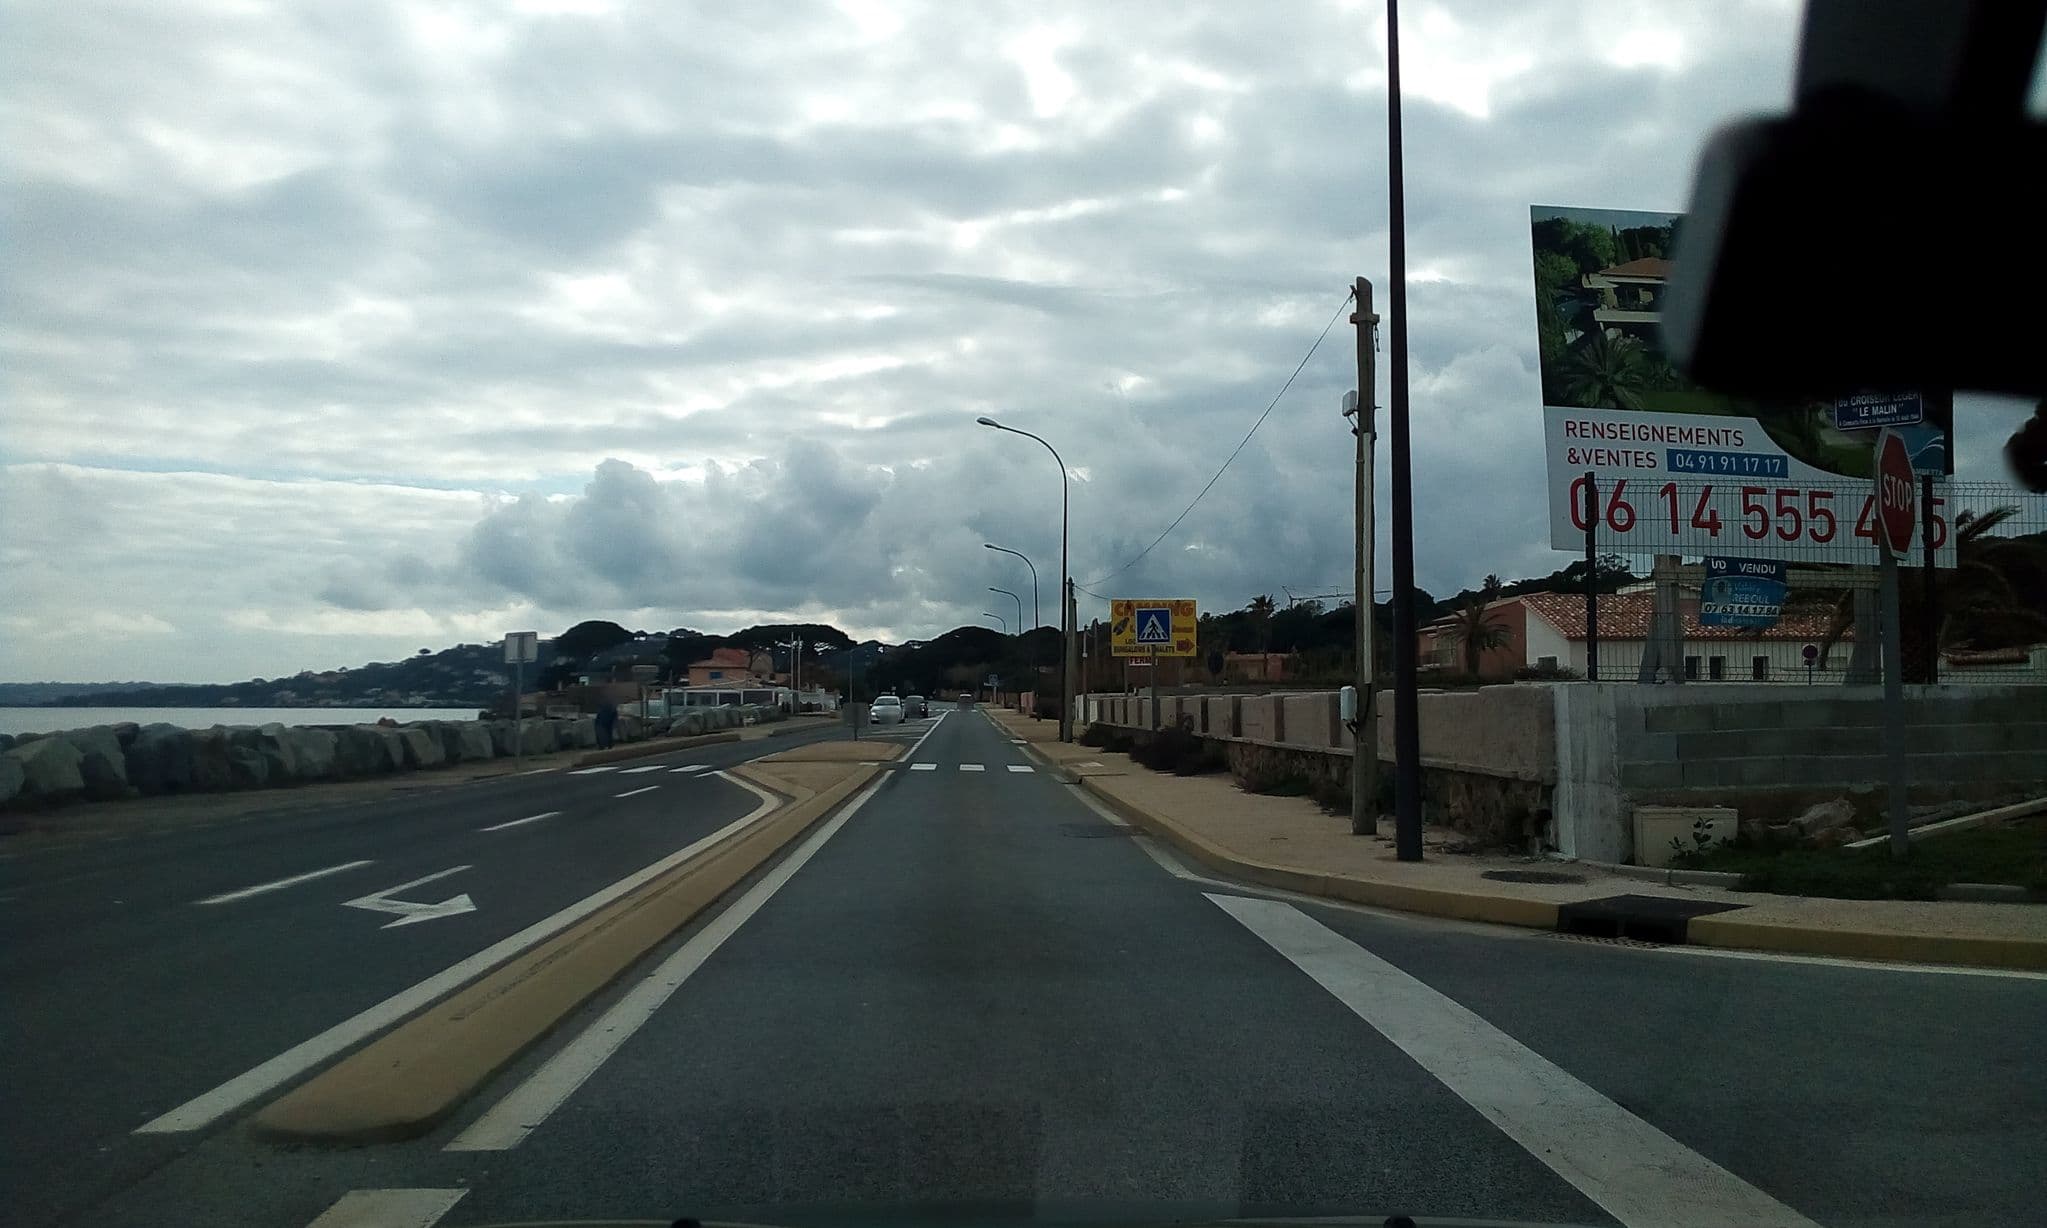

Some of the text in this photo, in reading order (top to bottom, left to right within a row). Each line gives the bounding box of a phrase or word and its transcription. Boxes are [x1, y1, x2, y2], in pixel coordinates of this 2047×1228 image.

[1565, 420, 1744, 447] RENSEIGNEMENTS
[1567, 447, 1658, 469] &VENTES
[1675, 453, 1781, 473] 04 91 91 17 17
[1883, 472, 1913, 513] STOP
[1569, 477, 1636, 533] 06
[1659, 482, 1722, 537] 14
[1742, 486, 1836, 544] 555
[1739, 562, 1776, 575] VENDU
